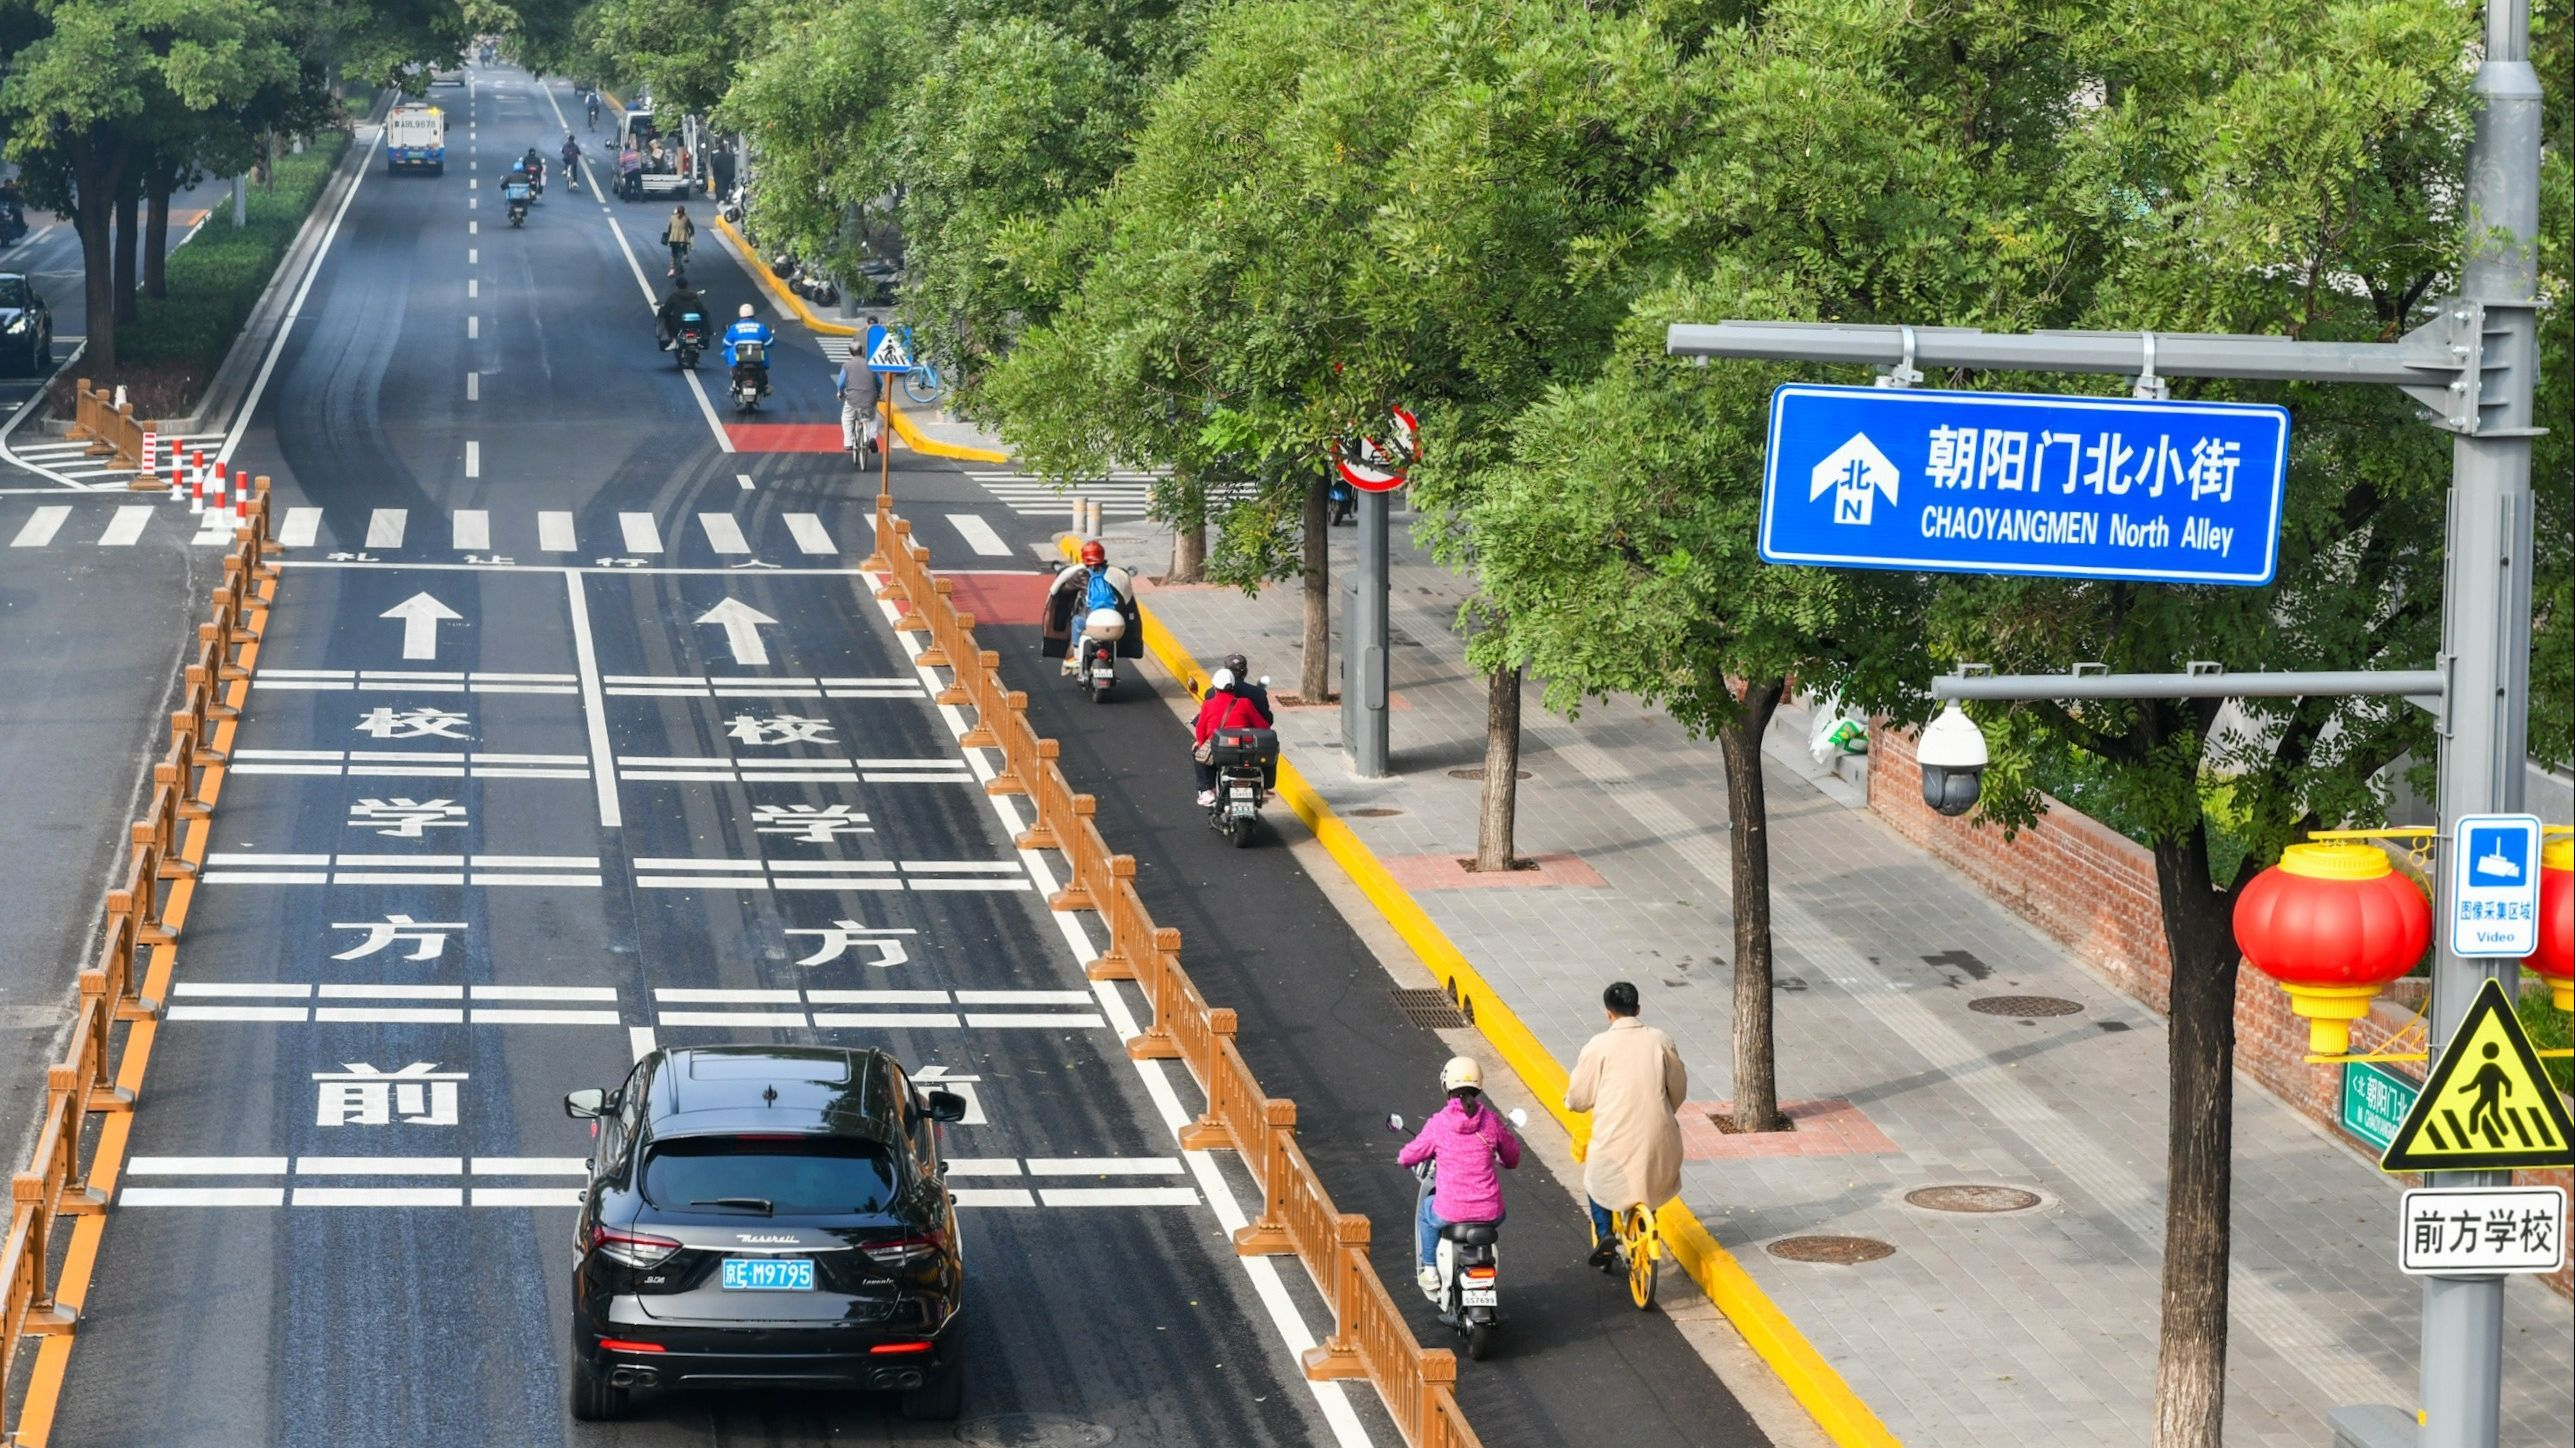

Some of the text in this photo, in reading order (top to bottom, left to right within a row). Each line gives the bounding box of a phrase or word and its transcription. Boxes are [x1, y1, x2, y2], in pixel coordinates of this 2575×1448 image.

[1840, 459, 1872, 490] 北
[1925, 424, 2240, 503] 朝阳门北小街
[1841, 499, 1862, 520] N
[1921, 505, 2233, 557] CHAOYANGMEN North Alley
[355, 707, 470, 739] 校
[724, 714, 839, 745] 校
[347, 797, 469, 838] 学
[751, 804, 875, 843] 学
[2461, 901, 2531, 920] 图像采集区域
[331, 914, 469, 961] 方
[784, 919, 917, 968] 方
[2477, 931, 2515, 943] Video
[311, 1061, 470, 1127] 前
[2413, 1208, 2553, 1254] 前方学校
